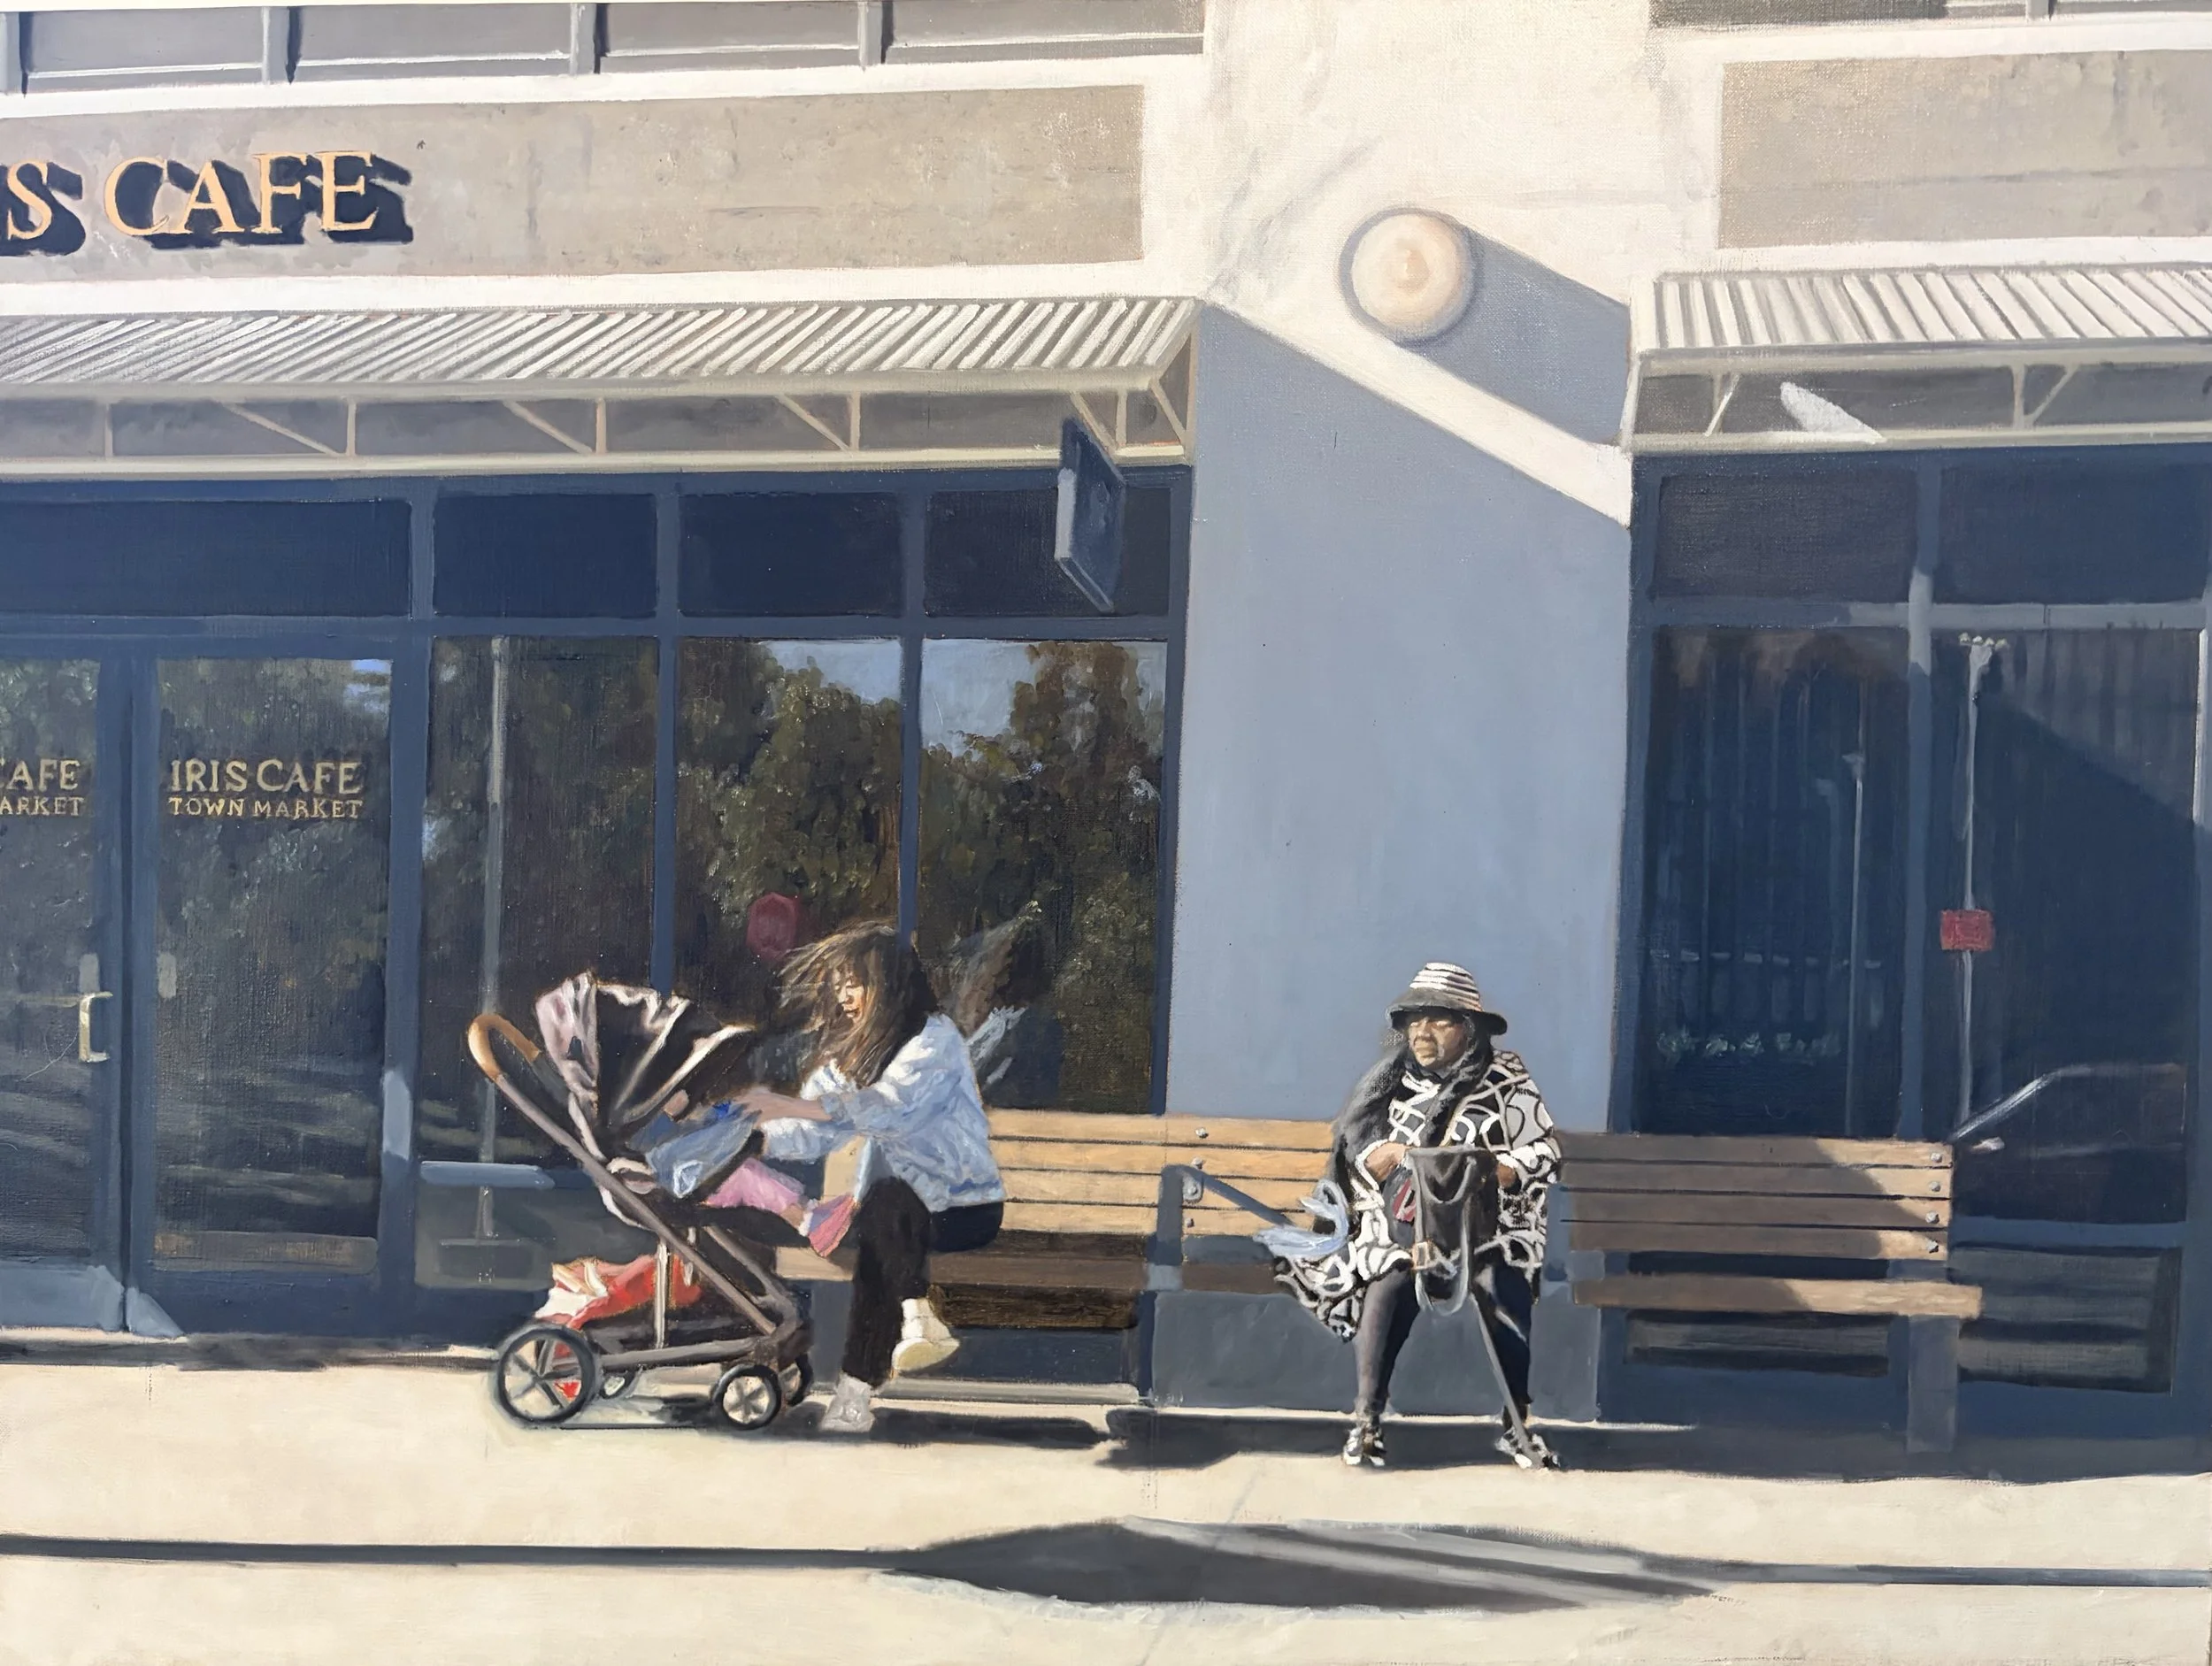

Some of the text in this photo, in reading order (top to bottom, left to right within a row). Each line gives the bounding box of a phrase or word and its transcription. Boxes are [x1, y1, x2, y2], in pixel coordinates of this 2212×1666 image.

[104, 150, 380, 236] CAFE
[171, 758, 364, 795] IRIS CAFE
[168, 796, 363, 820] TOWN MARKET
